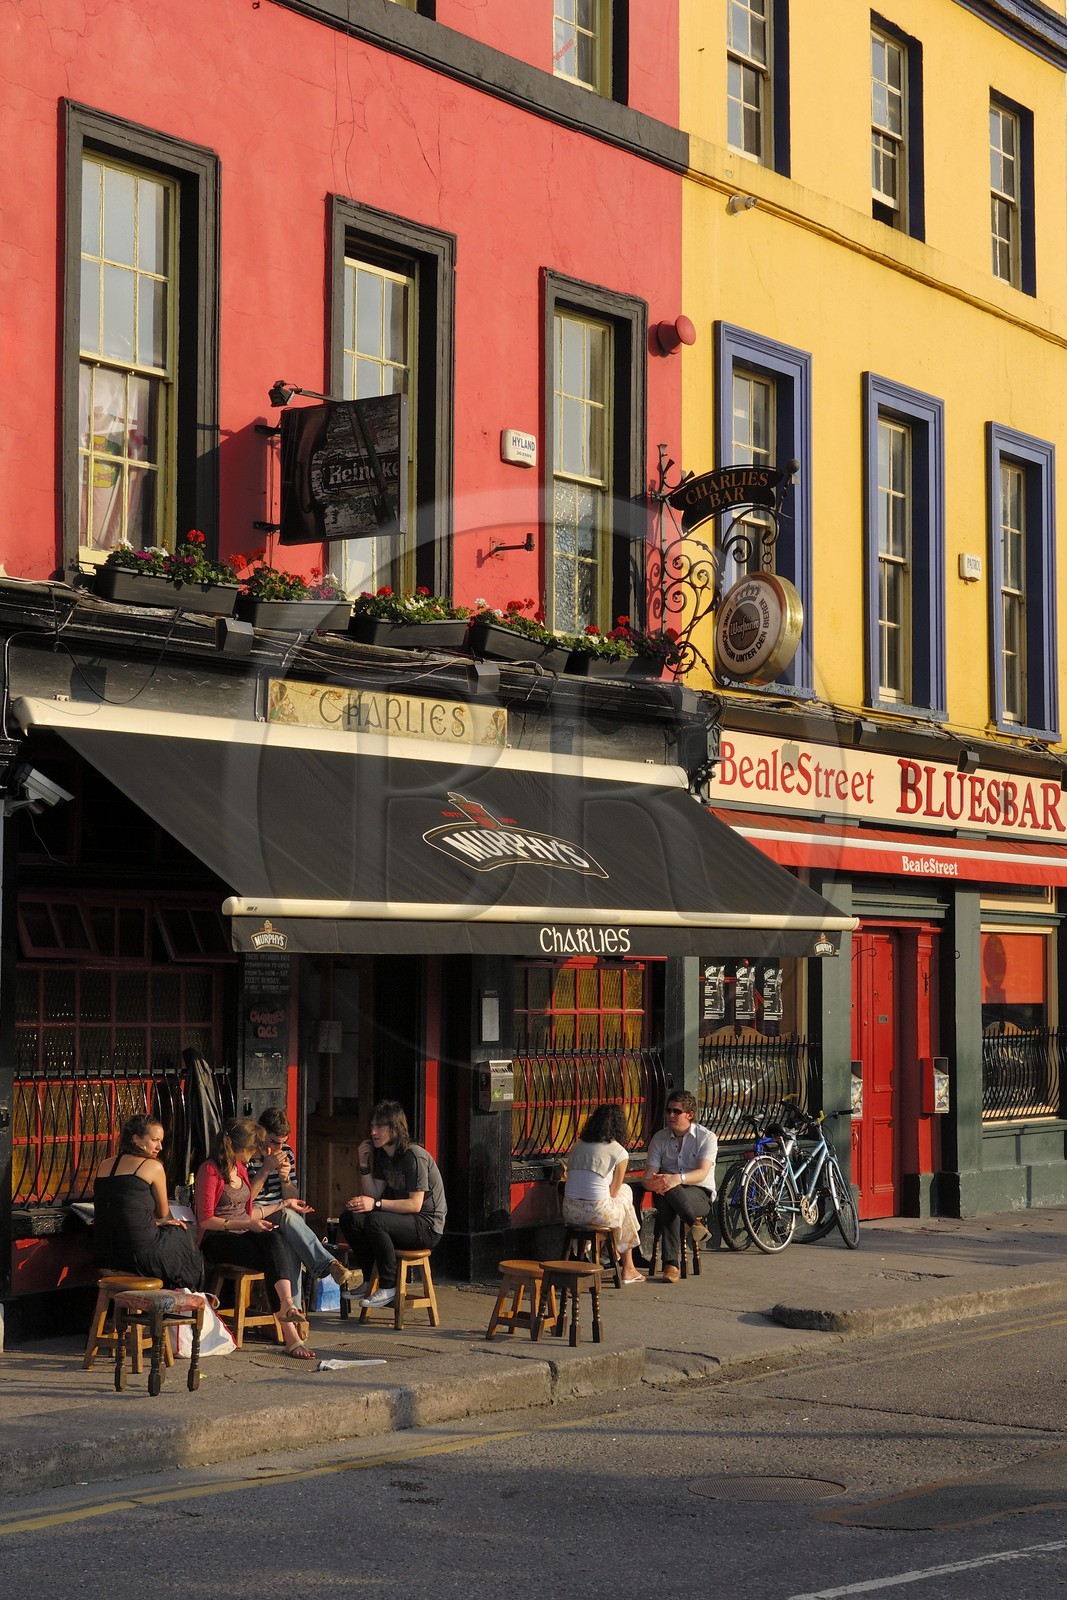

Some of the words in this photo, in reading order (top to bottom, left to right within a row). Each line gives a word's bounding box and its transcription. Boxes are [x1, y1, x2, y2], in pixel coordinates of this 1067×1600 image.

[512, 436, 535, 451] HYLAND
[685, 471, 768, 505] CHARLIES
[709, 487, 744, 508] BAR
[735, 648, 757, 663] UNTER
[756, 630, 768, 650] DEN
[319, 690, 465, 737] CHARLIES
[896, 758, 1066, 832] BLUESBAR
[902, 855, 959, 876] BealeStreet
